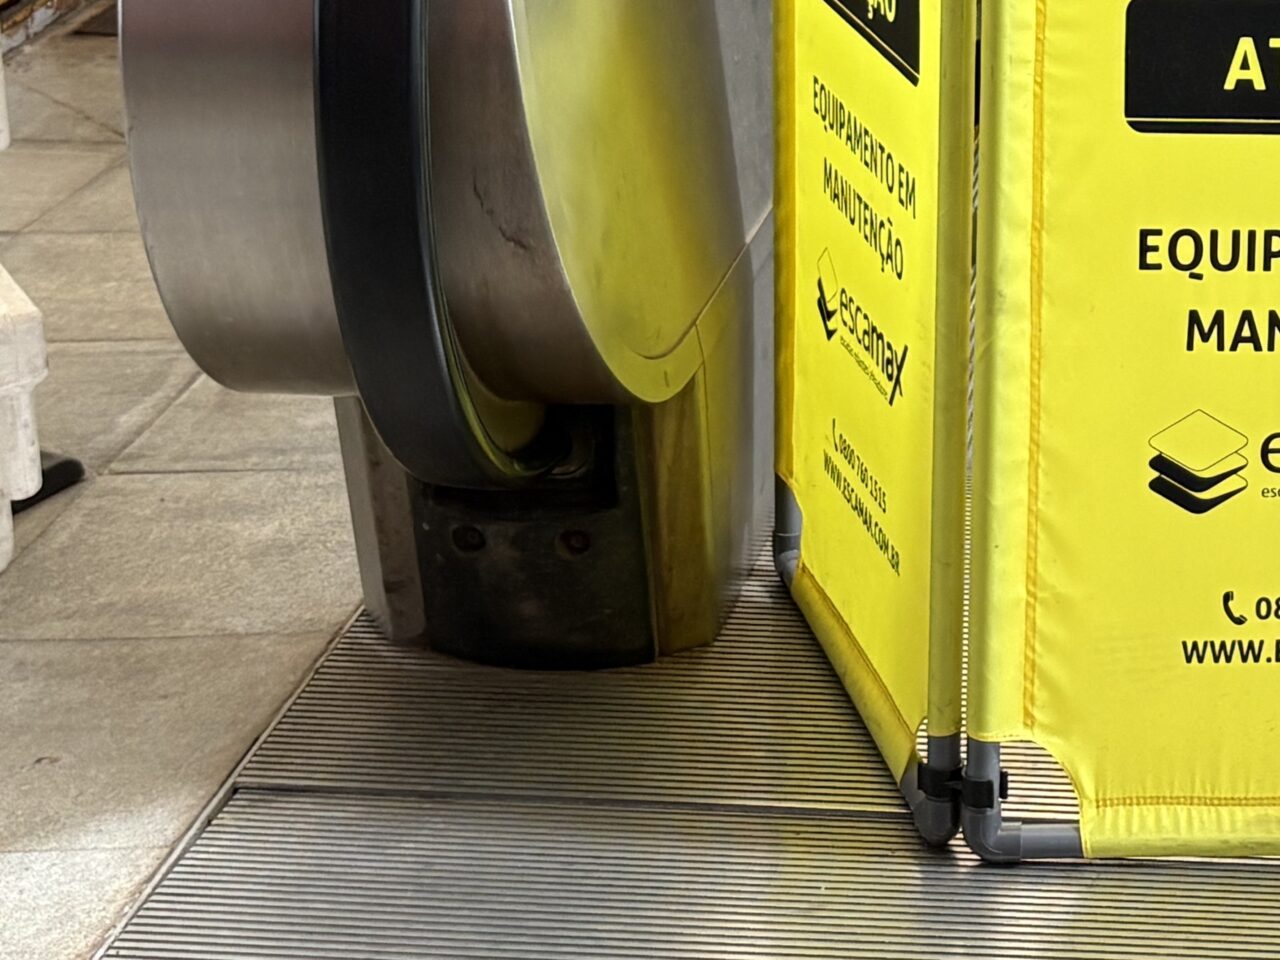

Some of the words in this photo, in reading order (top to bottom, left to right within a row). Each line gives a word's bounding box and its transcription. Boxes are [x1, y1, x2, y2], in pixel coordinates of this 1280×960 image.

[813, 75, 895, 195] EQUIPAMENTO
[899, 162, 917, 220] EM
[823, 156, 904, 281] MANUTENÇÃO
[839, 287, 909, 407] escamax
